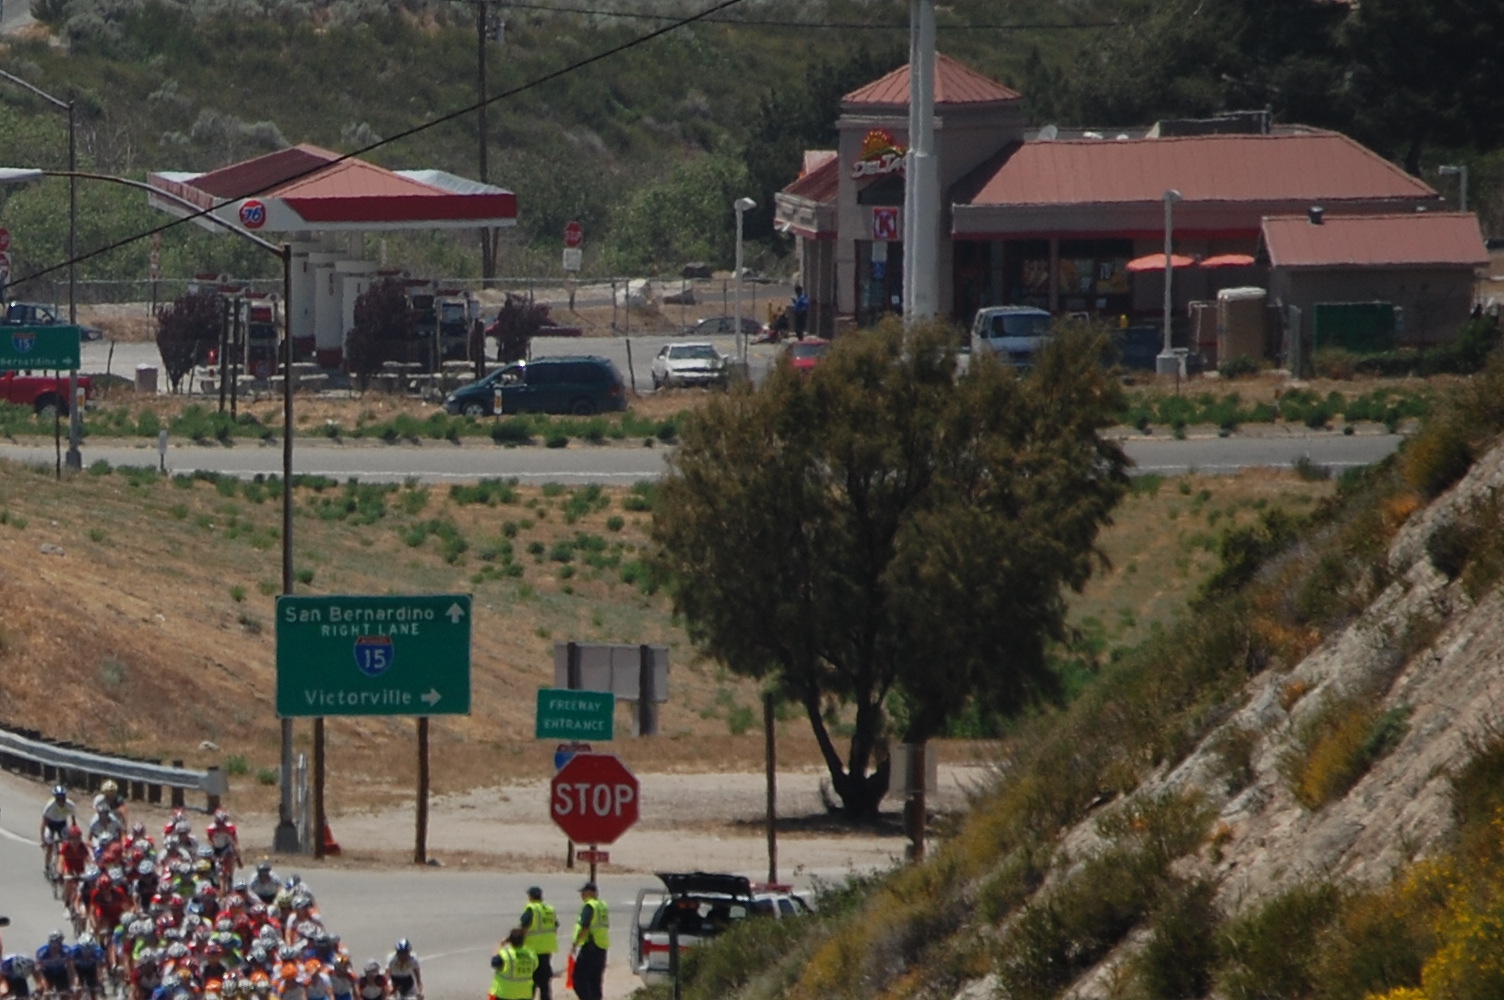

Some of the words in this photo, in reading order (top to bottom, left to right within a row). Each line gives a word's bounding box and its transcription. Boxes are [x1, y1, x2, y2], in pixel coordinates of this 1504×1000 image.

[241, 205, 264, 224] 76
[18, 339, 31, 350] 15
[0, 357, 57, 367] Bernardino
[285, 606, 322, 623] San
[329, 605, 435, 623] Bernardino
[321, 623, 371, 637] RIGHT
[378, 622, 420, 636] LANE
[364, 648, 387, 669] 15
[304, 689, 413, 706] Victorville
[549, 699, 602, 713] FREEWAY
[543, 718, 605, 731] ENTRANCE
[554, 782, 634, 817] STOP
